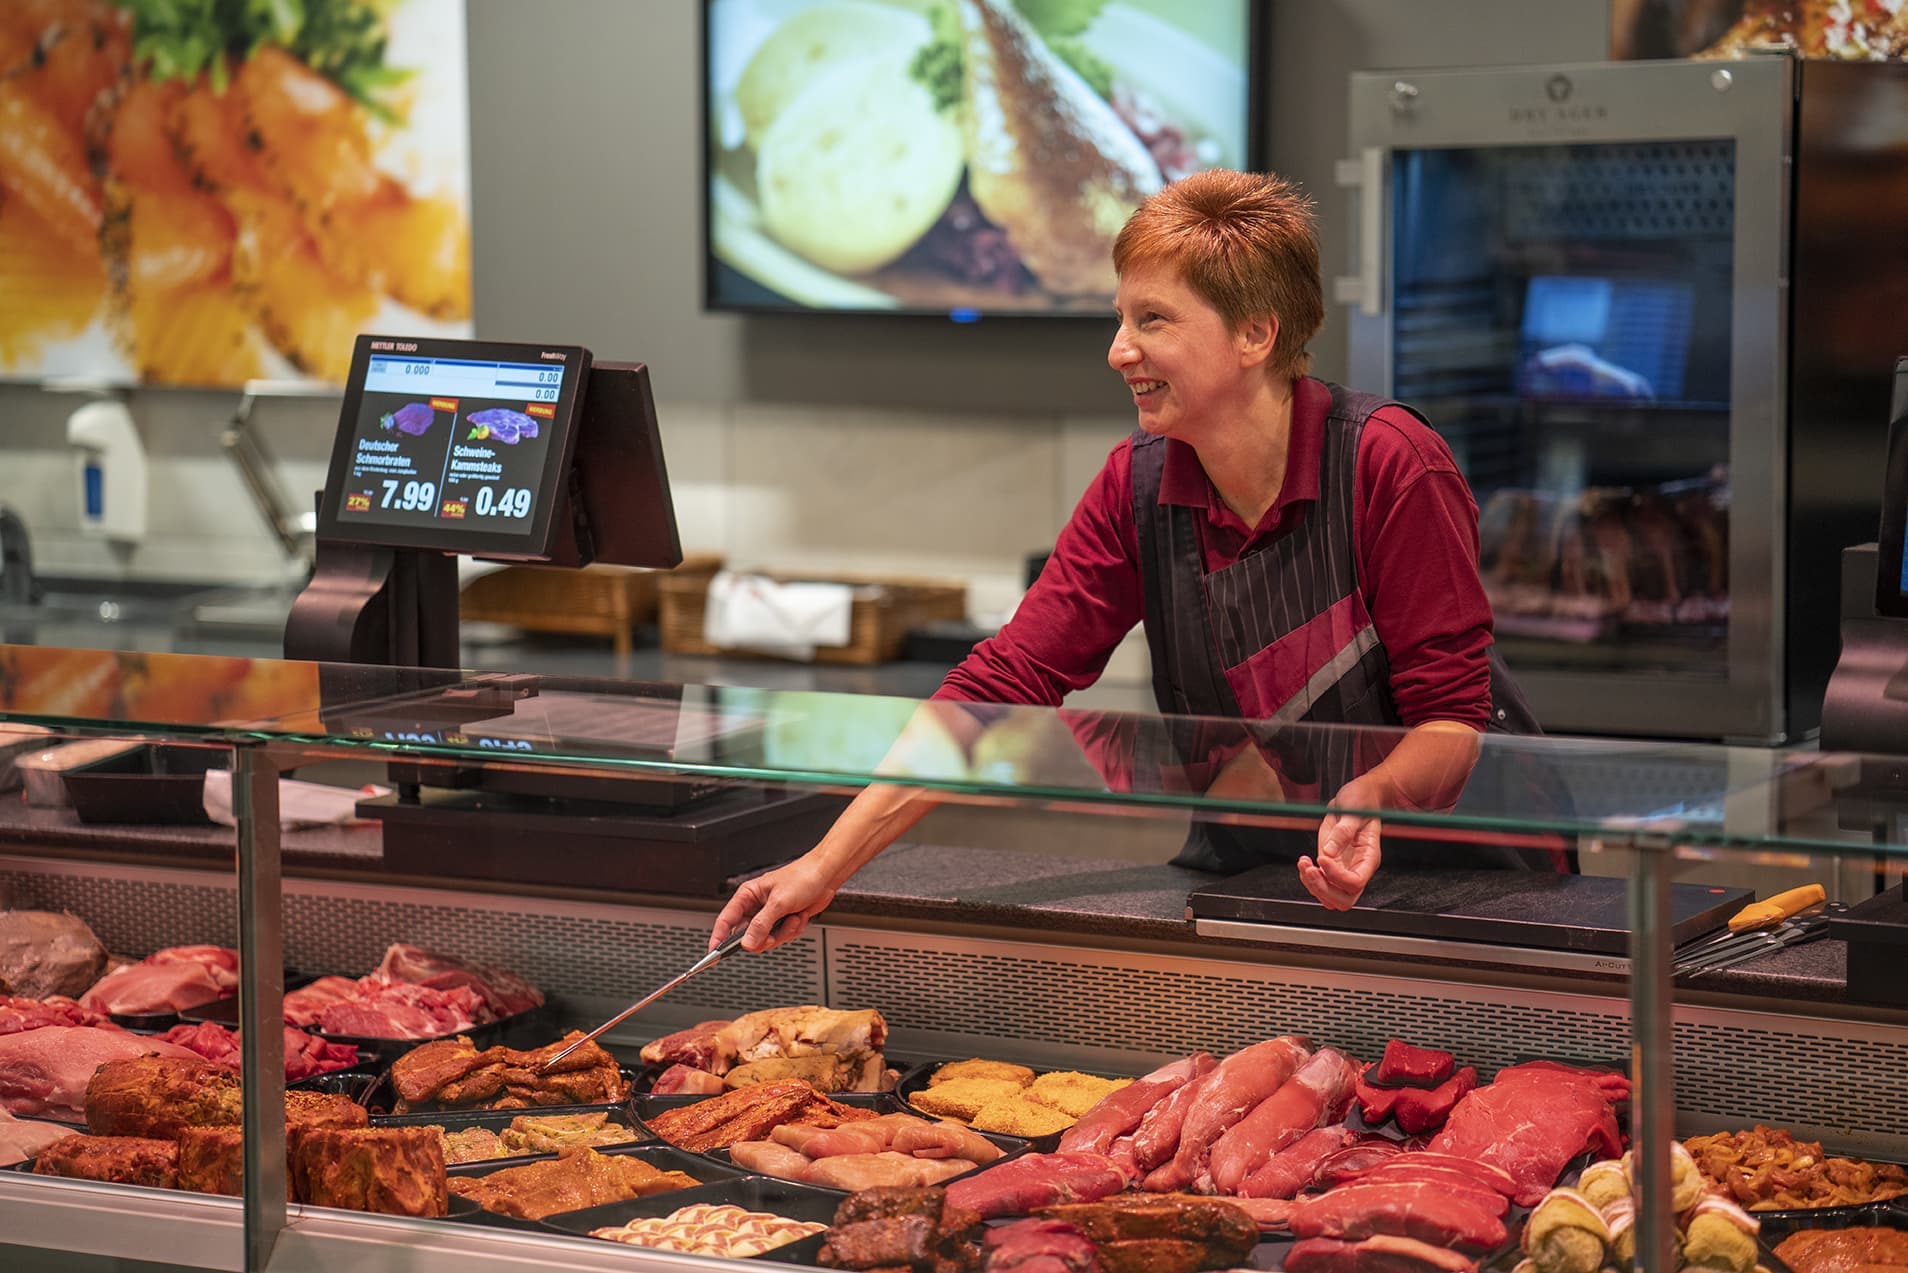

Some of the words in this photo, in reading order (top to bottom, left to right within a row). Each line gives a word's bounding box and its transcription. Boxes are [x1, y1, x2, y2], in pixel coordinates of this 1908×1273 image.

[370, 341, 394, 351] METTLER
[396, 343, 417, 352] TOLEDO
[405, 364, 430, 375] 0.000
[538, 372, 559, 383] 0.00
[535, 389, 555, 400] 0.00
[358, 438, 400, 452] Deutscher
[453, 444, 496, 459] Schweine-
[355, 452, 412, 468] Schmorbraten
[450, 459, 503, 473] Kammsteaks
[347, 495, 370, 507] 27%
[381, 479, 435, 511] 7.99
[442, 503, 465, 514] 44%
[475, 486, 531, 518] 0.49
